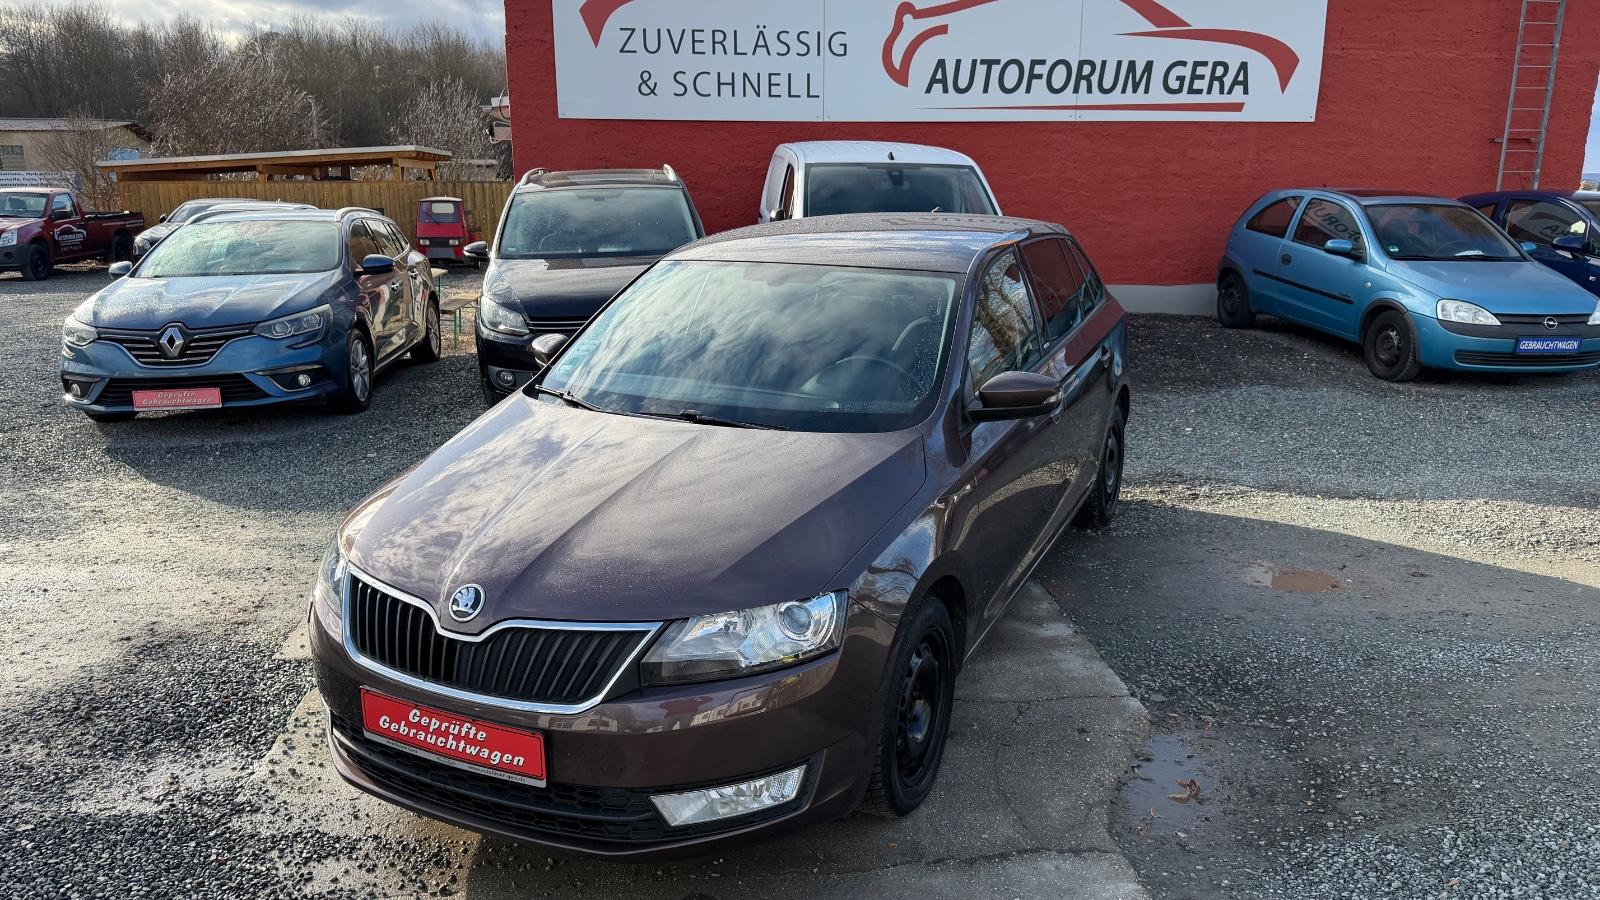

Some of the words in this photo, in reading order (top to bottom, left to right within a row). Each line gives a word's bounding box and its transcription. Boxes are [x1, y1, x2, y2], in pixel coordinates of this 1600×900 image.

[618, 24, 849, 57] ZUVERLÄSSIG
[637, 69, 659, 97] &
[672, 70, 820, 99] SCHNELL
[924, 58, 1155, 96] AUTOFORUM
[1161, 60, 1250, 96] GERA
[1519, 340, 1579, 350] GEBRAUCHTWAGEN
[142, 397, 213, 406] Gebrauchtwagen
[378, 715, 525, 767] Gebrauchtwagen
[408, 708, 487, 742] Geprüfte
